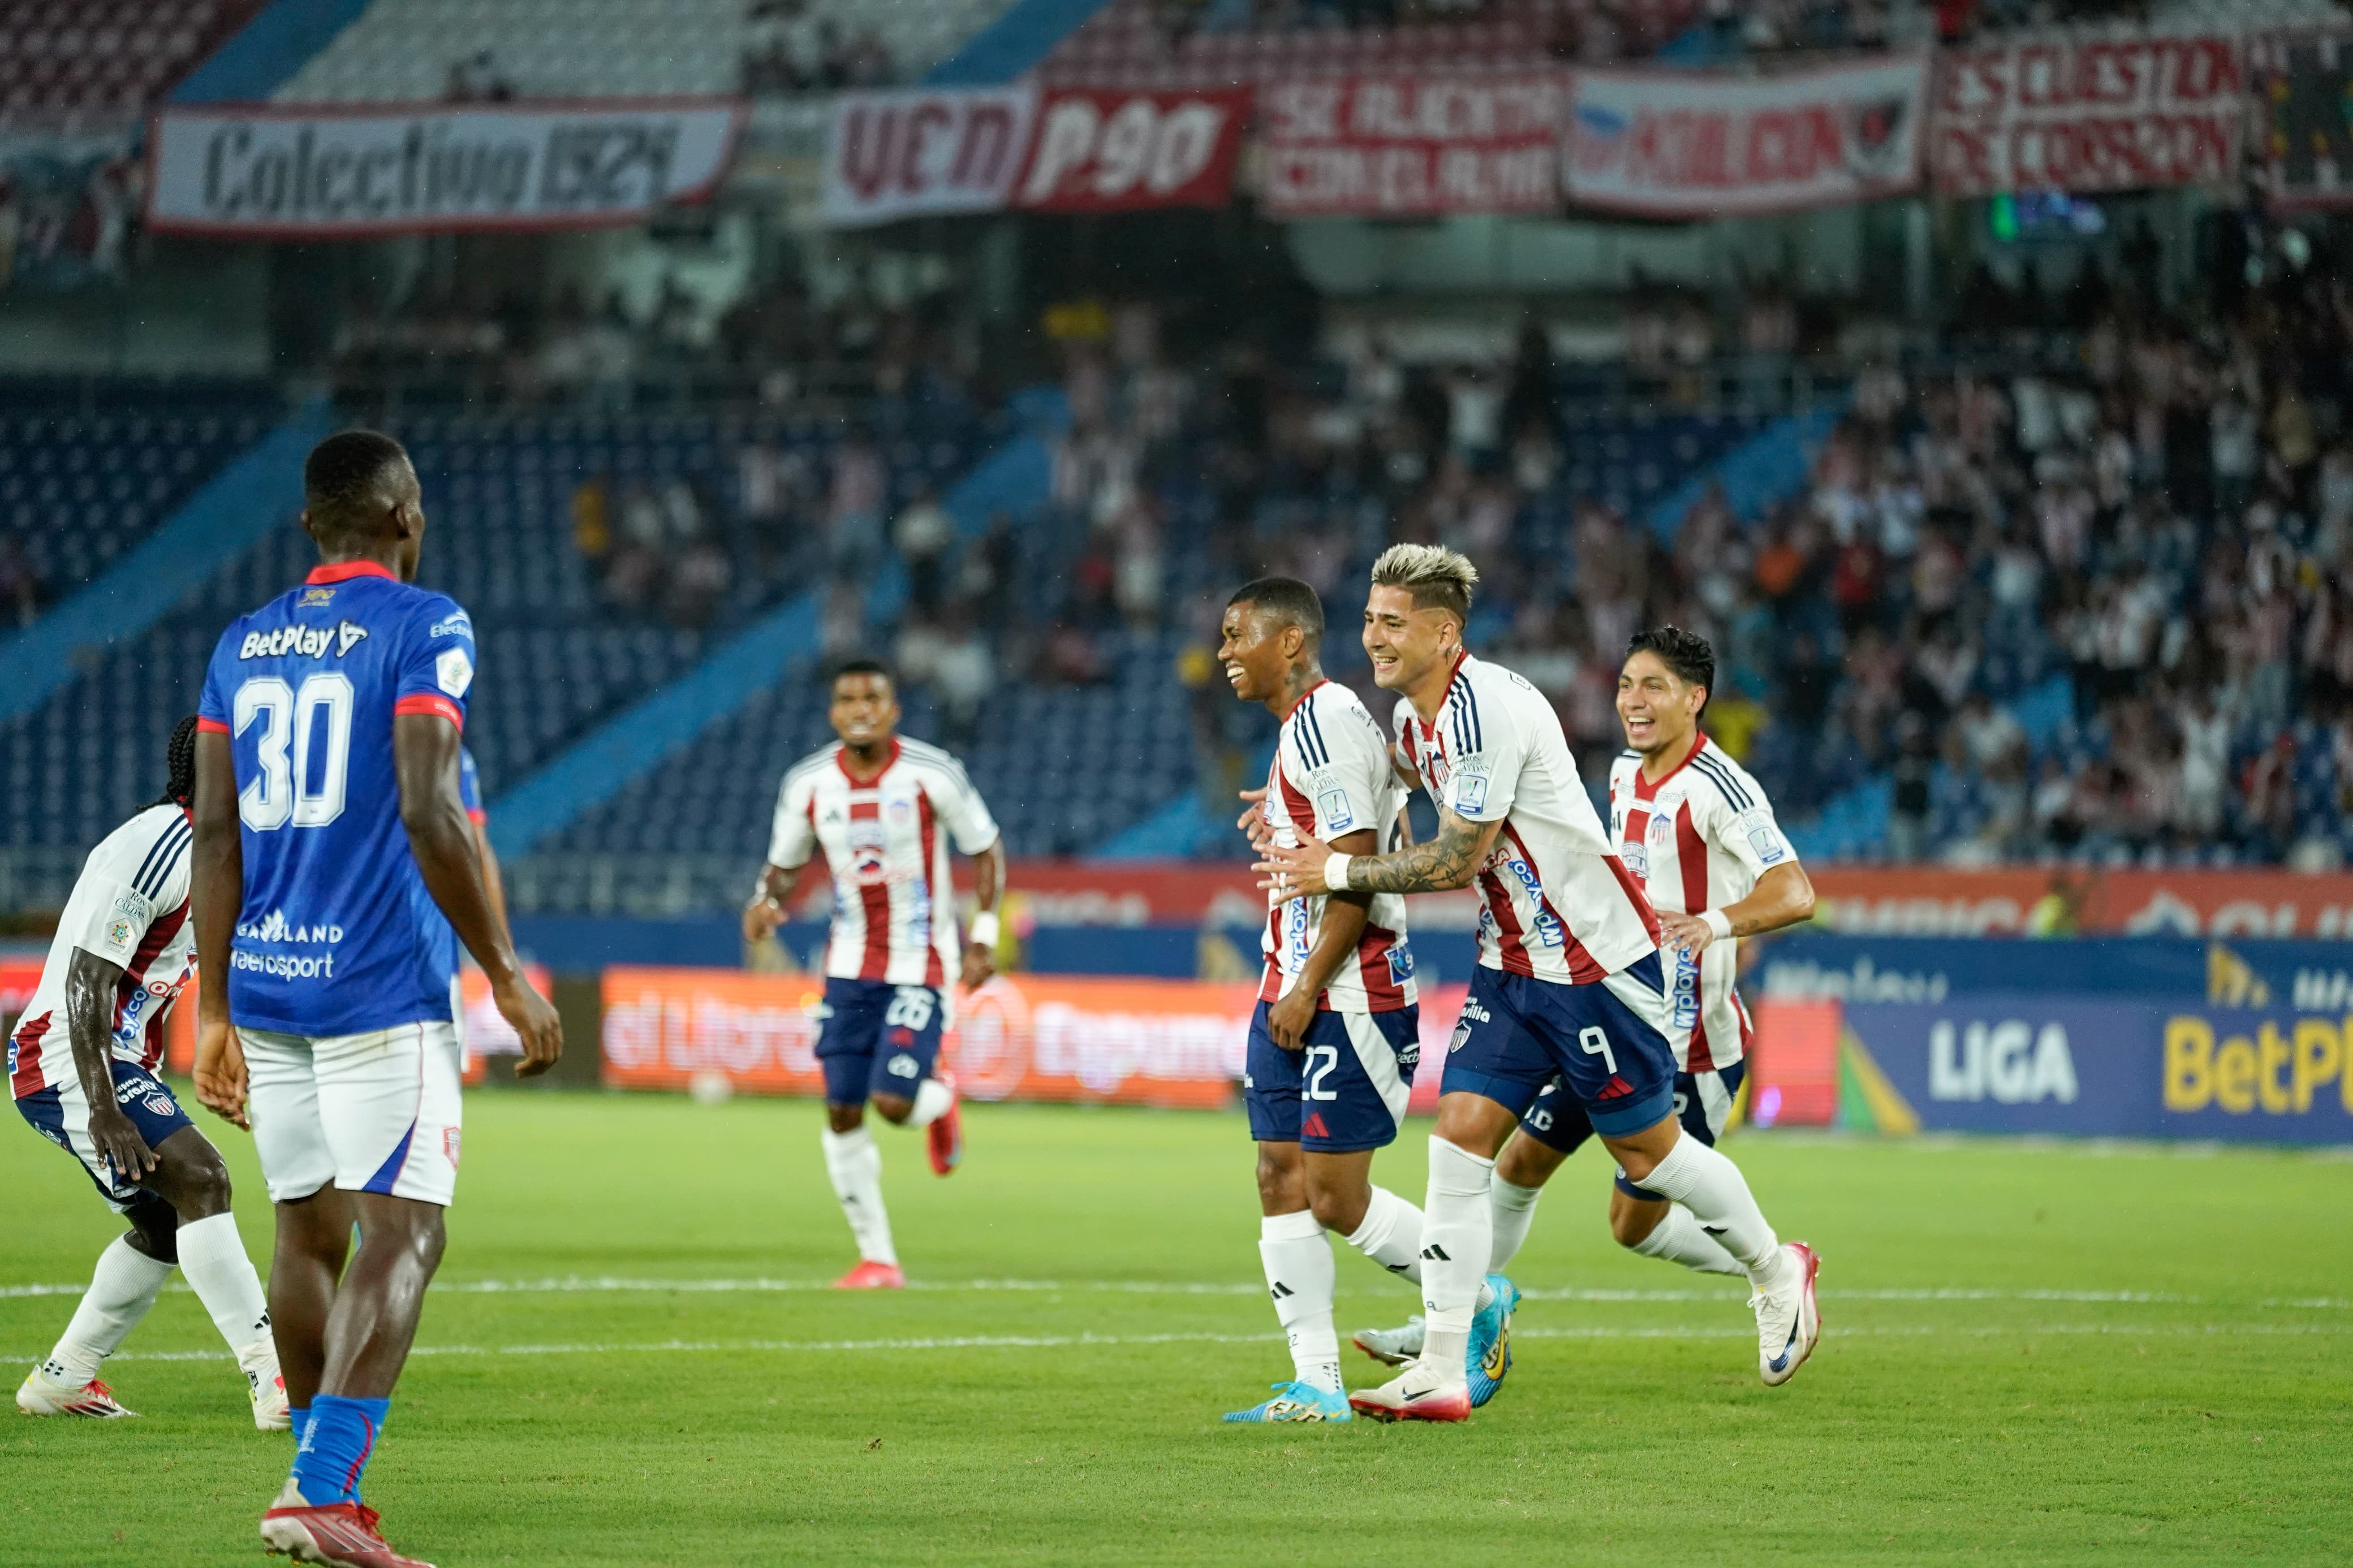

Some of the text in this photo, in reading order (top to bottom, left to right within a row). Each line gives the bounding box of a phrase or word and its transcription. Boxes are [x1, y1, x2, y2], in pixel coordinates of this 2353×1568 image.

[239, 623, 336, 660] BetPlay
[233, 671, 355, 833] 30
[115, 897, 146, 919] CALDAS
[131, 892, 147, 906] RON
[886, 986, 935, 1031] 26
[1579, 1026, 1617, 1074] 9
[1928, 1020, 2079, 1105] LIGA
